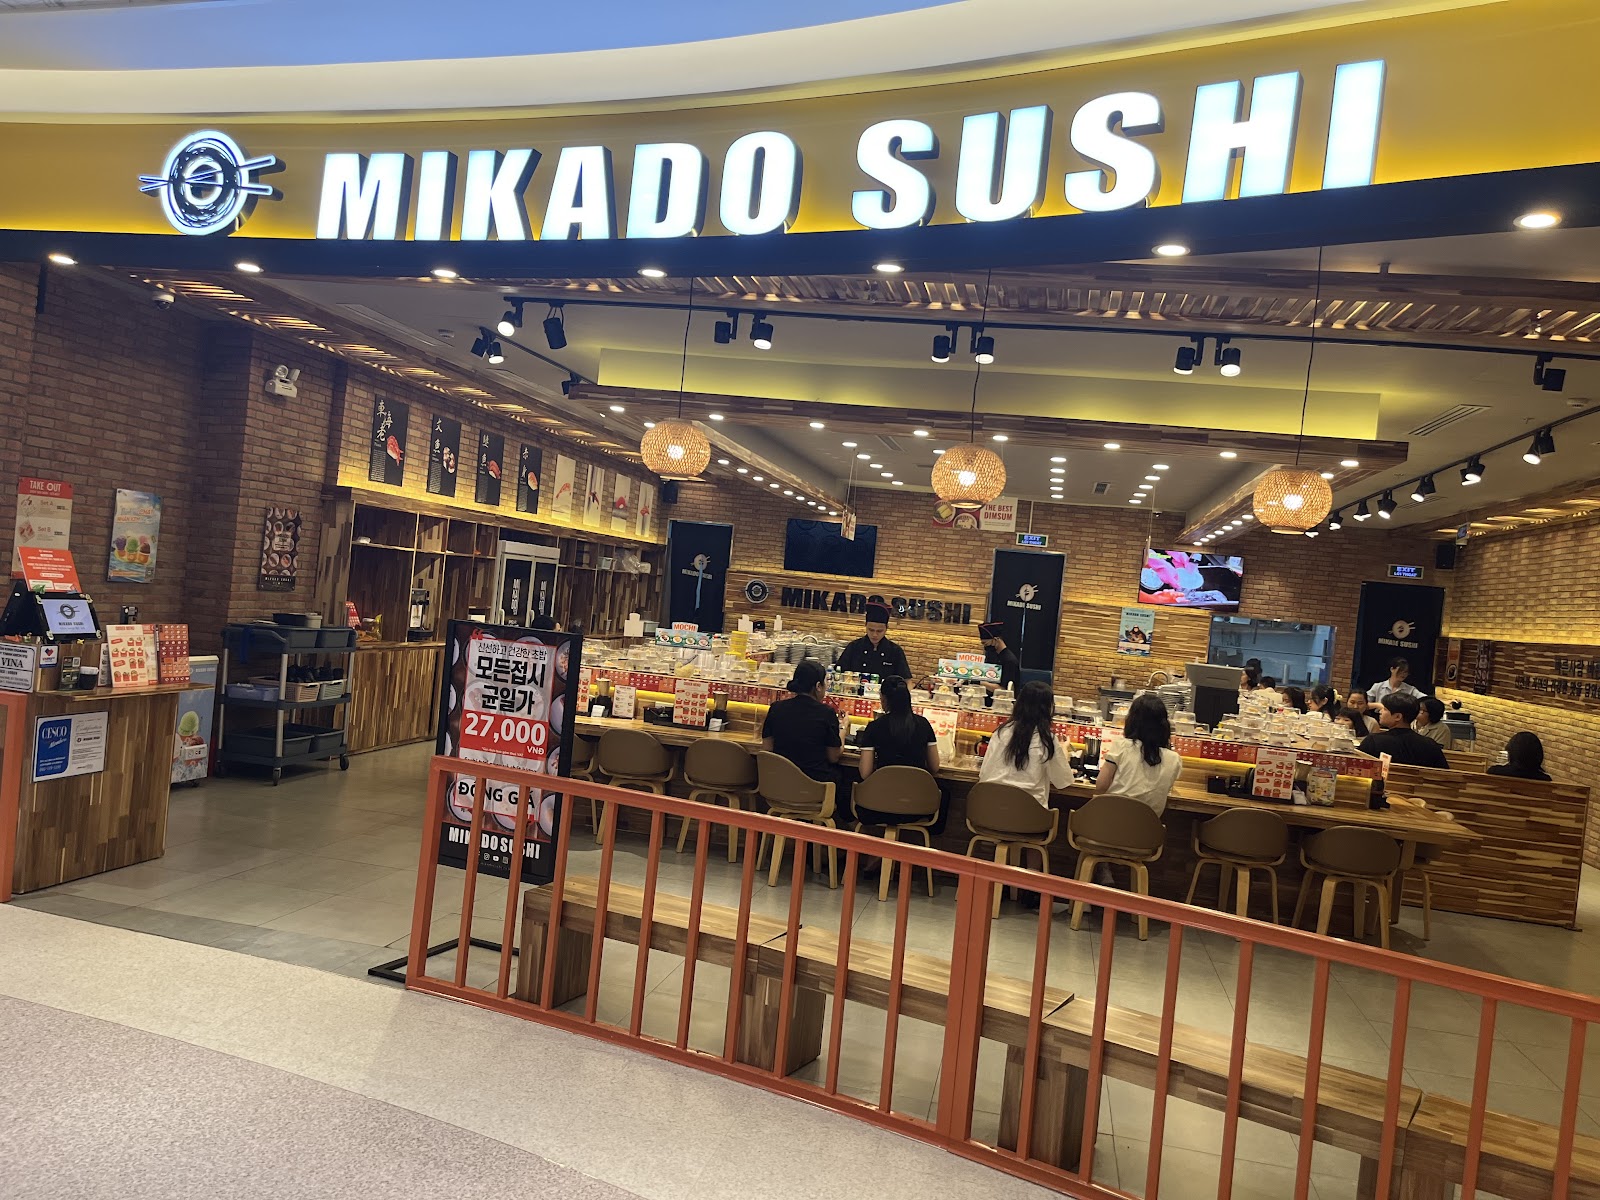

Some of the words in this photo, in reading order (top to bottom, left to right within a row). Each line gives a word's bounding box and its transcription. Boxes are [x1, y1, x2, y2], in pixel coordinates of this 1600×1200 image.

[316, 131, 796, 242] MIKADO
[851, 59, 1386, 230] SUSHI
[30, 480, 45, 490] TAKE
[47, 483, 61, 492] OUT
[985, 504, 997, 512] THE
[998, 504, 1013, 513] BEST
[984, 512, 1013, 521] DIMSUM
[891, 597, 972, 625] SUSHI
[674, 624, 696, 632] MOCHI
[478, 642, 507, 656] 신선하고
[508, 645, 531, 659] 건강한
[532, 649, 547, 661] 초밥
[1400, 641, 1418, 649] SUSHI
[1, 657, 24, 668] VINA
[475, 656, 546, 688] 모든접시
[481, 685, 535, 716] 균일가
[42, 726, 67, 740] CESCO
[464, 712, 547, 747] 27,000
[527, 745, 545, 756] VNĐ
